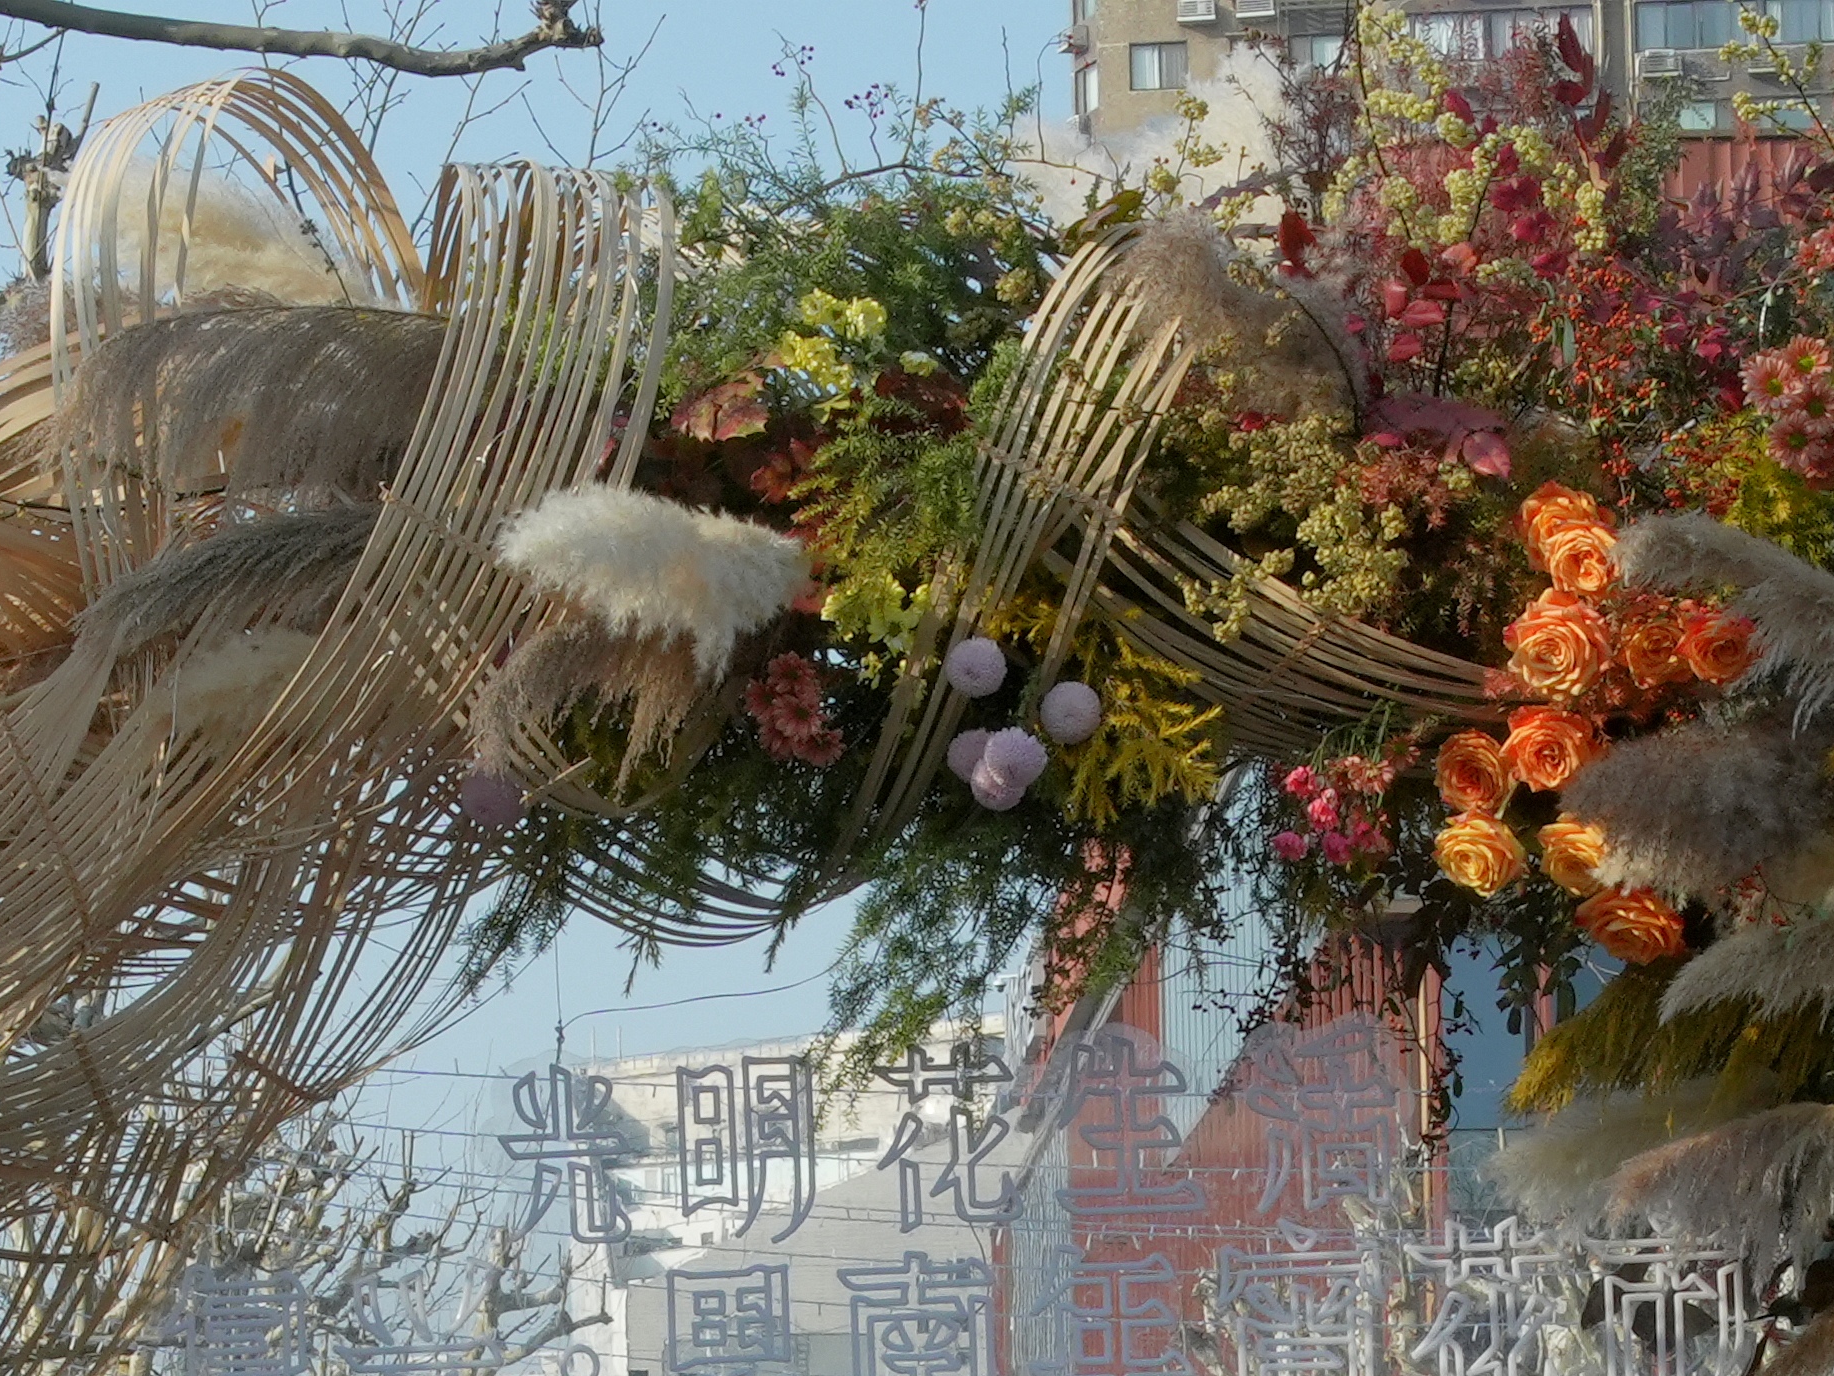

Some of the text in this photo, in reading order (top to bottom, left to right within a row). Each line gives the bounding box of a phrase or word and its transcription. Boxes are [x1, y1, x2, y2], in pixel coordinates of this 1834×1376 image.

[496, 1026, 1399, 1245] 光明花生活
